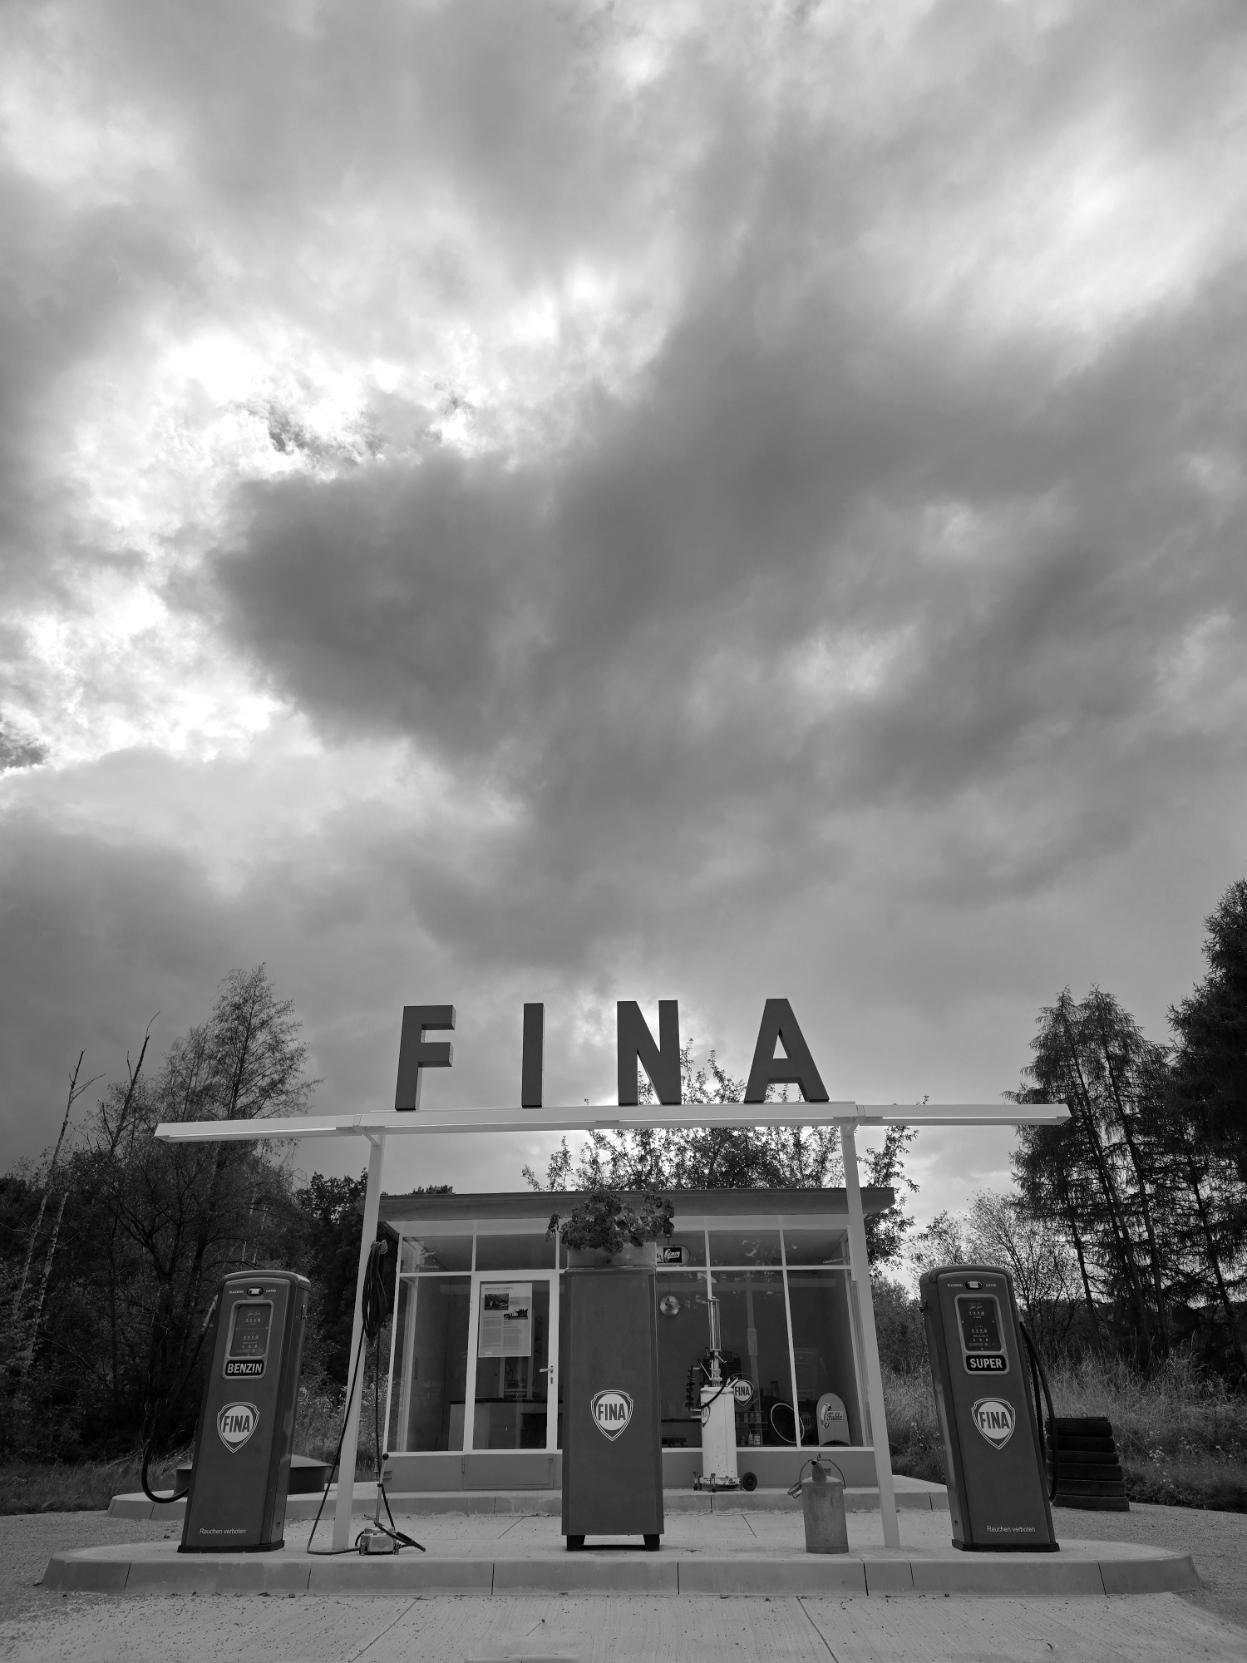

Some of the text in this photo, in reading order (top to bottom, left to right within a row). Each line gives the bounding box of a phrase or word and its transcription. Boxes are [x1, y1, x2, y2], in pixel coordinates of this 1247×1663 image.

[395, 998, 830, 1111] FINA
[227, 1363, 263, 1374] BENZIN
[969, 1358, 1003, 1369] SUPER
[734, 1385, 751, 1397] FINA
[597, 1403, 627, 1421] FINA
[222, 1415, 250, 1433] FINA
[978, 1411, 1010, 1430] FINA
[199, 1527, 247, 1535] Rauchen verboten
[986, 1525, 1036, 1533] Rauchen verboten
